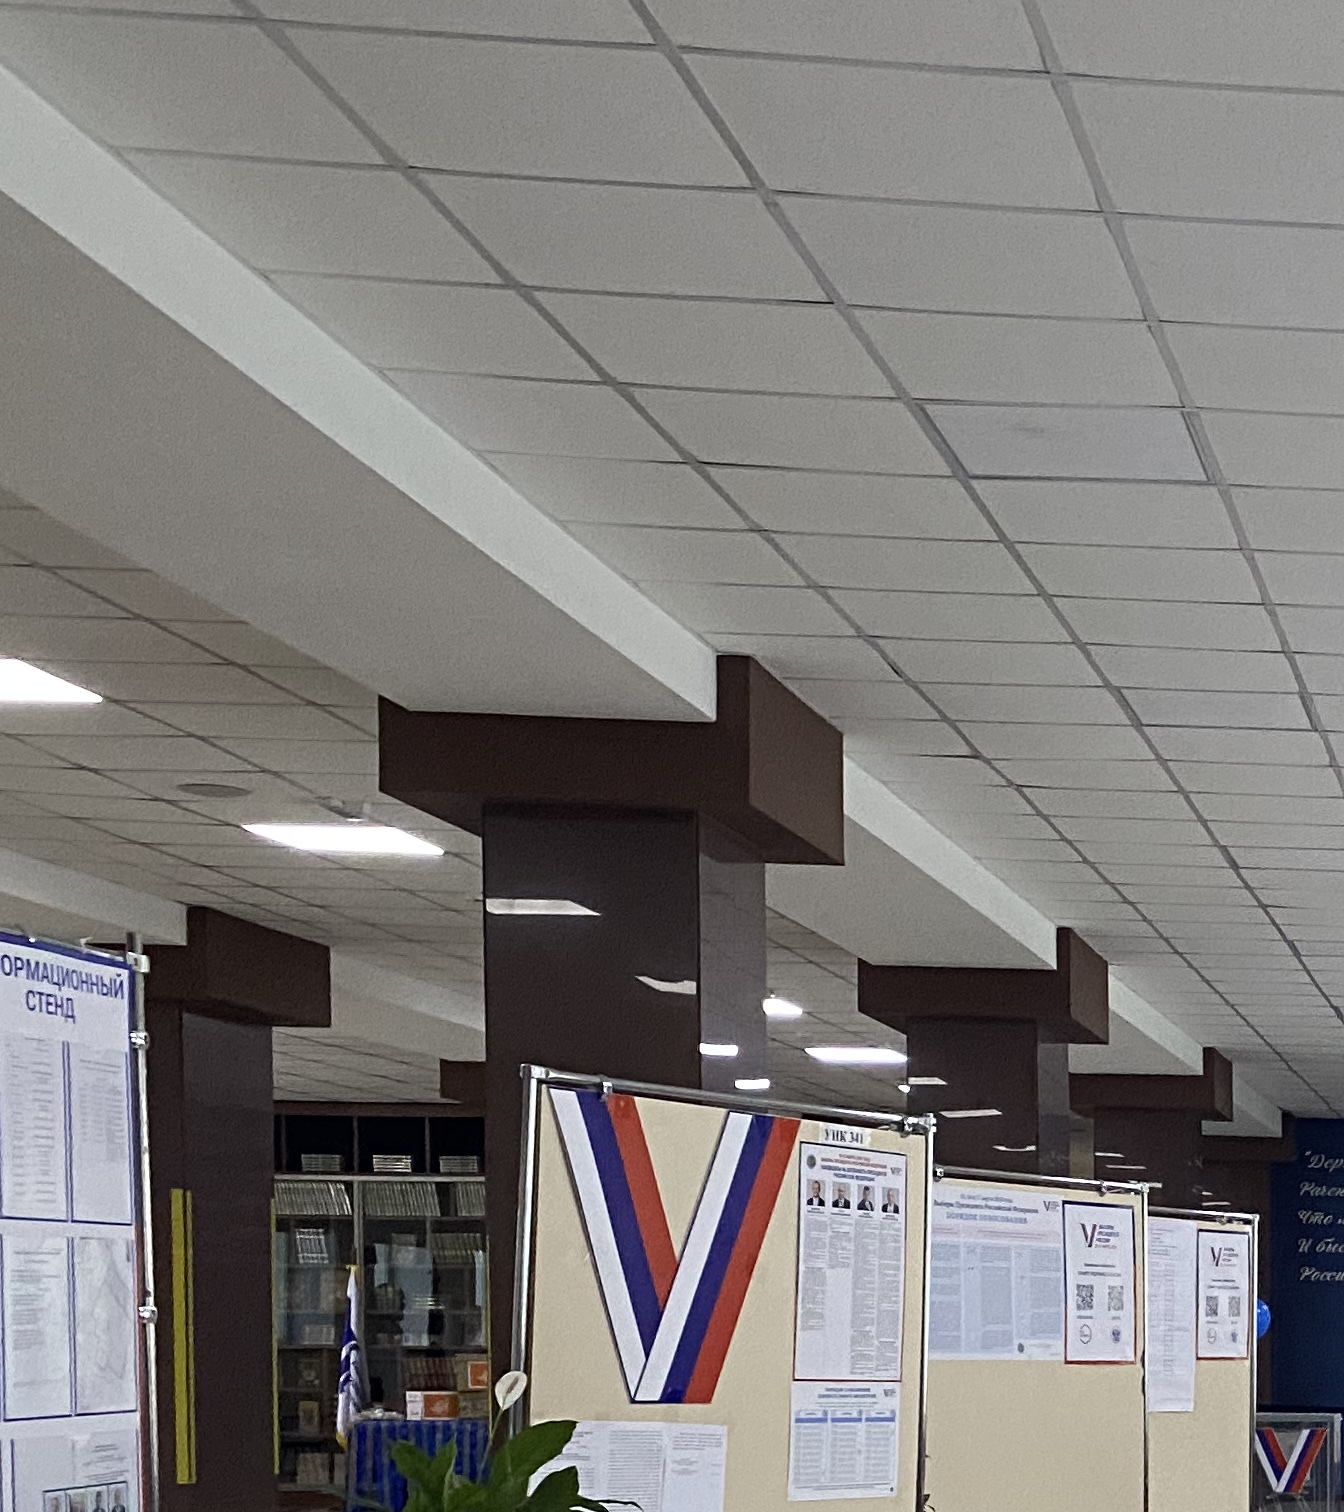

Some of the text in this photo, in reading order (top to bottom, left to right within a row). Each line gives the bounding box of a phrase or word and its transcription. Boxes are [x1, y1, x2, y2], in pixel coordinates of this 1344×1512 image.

[26, 990, 76, 1024] СТЕНД
[825, 1128, 847, 1143] УИК
[1298, 1209, 1333, 1225] Что
